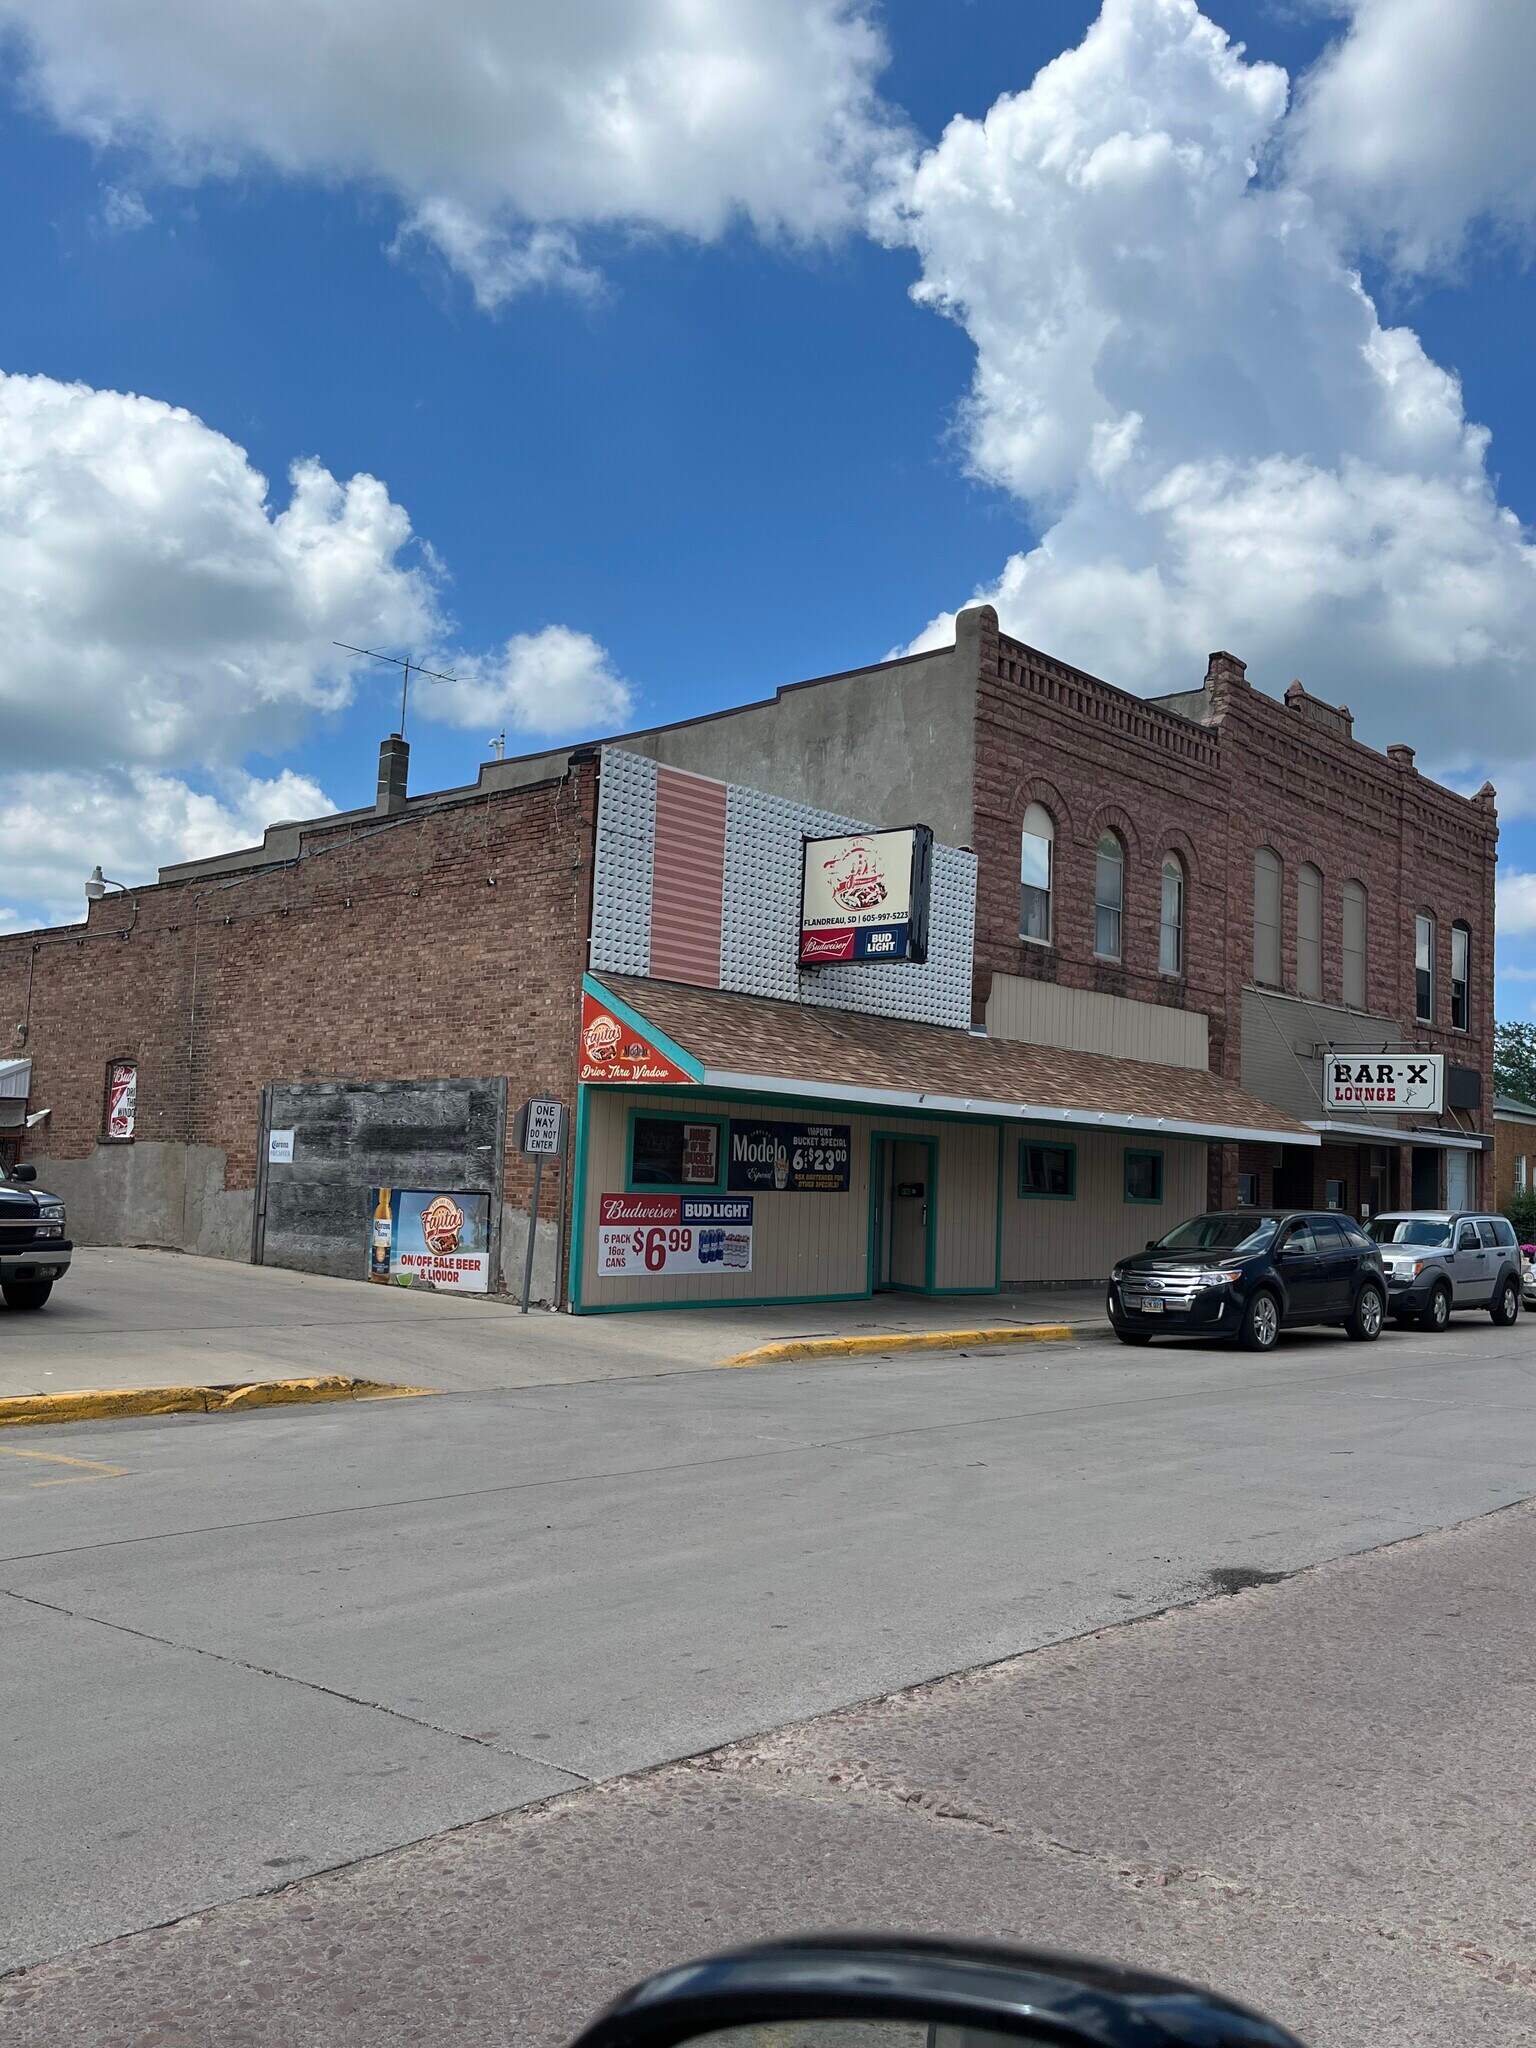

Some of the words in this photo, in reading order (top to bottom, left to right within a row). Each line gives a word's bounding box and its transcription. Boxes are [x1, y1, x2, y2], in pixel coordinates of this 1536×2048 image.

[804, 915, 846, 926] FLANDREAU,
[847, 915, 857, 924] SD
[862, 911, 908, 922] 605-997-5223
[872, 933, 892, 942] BUD
[804, 940, 847, 952] Budweiser
[866, 942, 896, 952] LIGHT
[581, 1064, 606, 1078] Drive
[608, 1065, 630, 1078] Thru
[632, 1064, 668, 1079] Window
[1334, 1064, 1428, 1084] BAR-X
[1335, 1087, 1396, 1102] LOUNGE
[536, 1106, 555, 1116] ONE
[536, 1118, 554, 1128] WAY
[530, 1130, 540, 1138] DO
[543, 1130, 556, 1139] NOT
[808, 1127, 832, 1137] IMPORT
[532, 1140, 554, 1150] ENTER
[733, 1134, 787, 1162] Modelo
[793, 1136, 819, 1146] BUCKET
[820, 1138, 846, 1148] SPECIAL
[792, 1149, 804, 1170] 6
[604, 1200, 678, 1219] Budweiser
[685, 1204, 714, 1218] BUD
[714, 1204, 748, 1218] LIGHT
[604, 1234, 610, 1244] 6
[612, 1234, 631, 1244] PACK
[608, 1246, 624, 1256] 16oz
[401, 1254, 432, 1268] ON/OFF
[434, 1256, 454, 1269] SALE
[456, 1258, 480, 1271] BEER
[606, 1258, 626, 1268] CANS
[420, 1269, 426, 1280] &
[428, 1270, 460, 1282] LIQUOR
